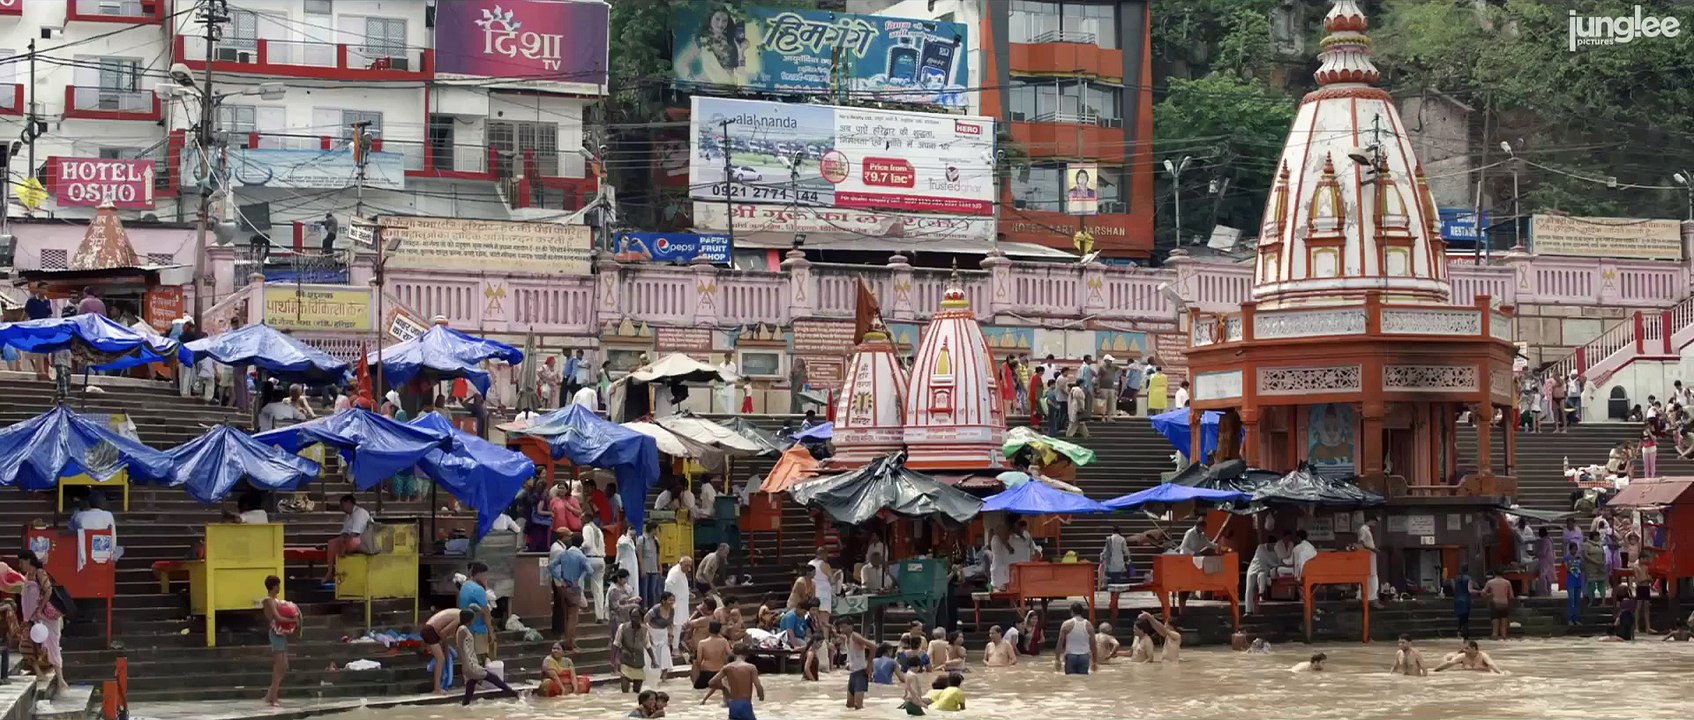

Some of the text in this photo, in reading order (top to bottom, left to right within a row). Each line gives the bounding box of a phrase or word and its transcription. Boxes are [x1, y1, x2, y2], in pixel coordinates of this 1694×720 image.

[477, 14, 563, 58] दिशा
[762, 12, 879, 58] हिमगंगे
[542, 59, 561, 70] TV
[873, 125, 895, 136] हरिद्वार
[62, 162, 142, 182] HOTEL
[890, 164, 907, 172] from
[68, 183, 135, 201] OSHO
[753, 187, 787, 199] 2771
[815, 212, 849, 223] का
[1049, 225, 1077, 235] AART
[700, 236, 727, 244] PAPPU
[670, 243, 695, 251] pepsi
